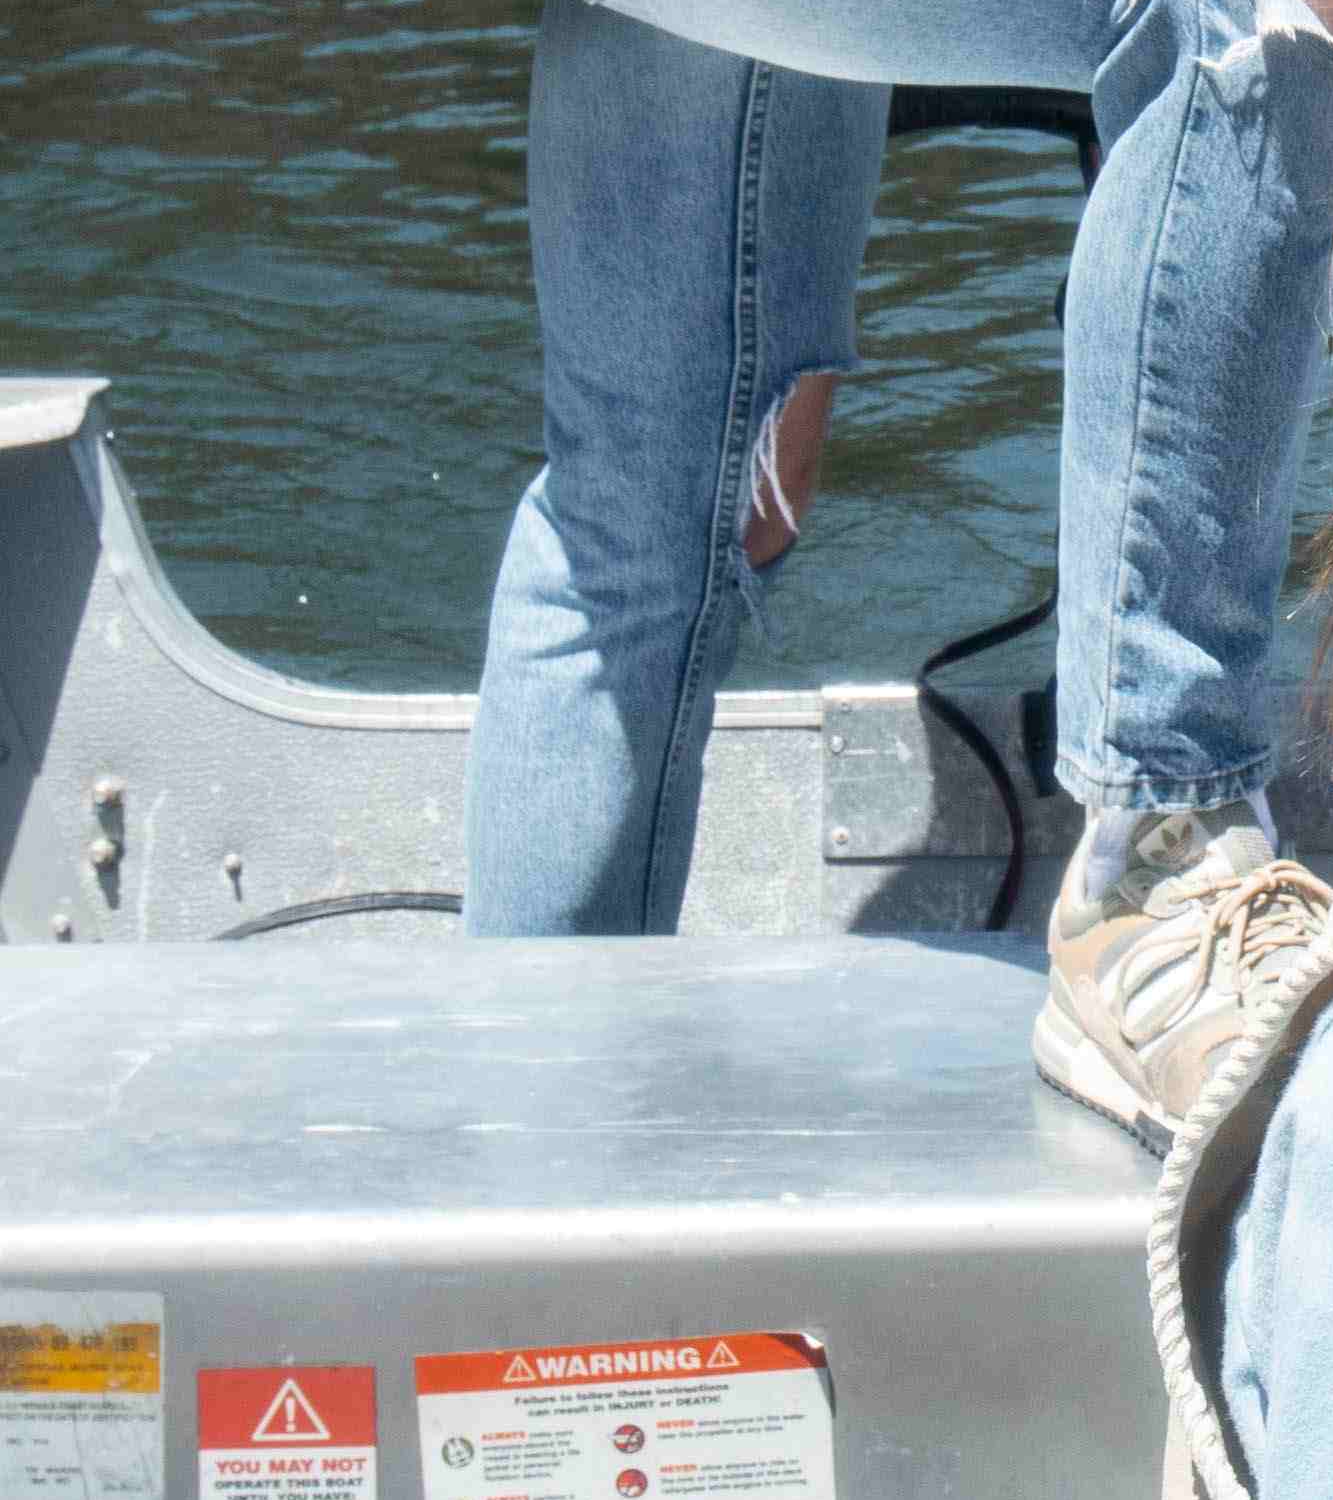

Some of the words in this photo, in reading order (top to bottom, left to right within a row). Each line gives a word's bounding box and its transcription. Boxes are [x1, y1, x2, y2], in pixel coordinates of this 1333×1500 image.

[536, 1347, 700, 1379] WARNING
[515, 1395, 556, 1406] Failure
[560, 1394, 573, 1403] to
[576, 1391, 613, 1402] follow
[618, 1388, 652, 1398] these
[656, 1383, 729, 1396] instructions
[607, 1400, 655, 1411] INJURY
[215, 1459, 261, 1475] YOU
[269, 1458, 314, 1473] MAY
[322, 1457, 368, 1472] NOT
[214, 1479, 281, 1490] OPERATE
[286, 1478, 320, 1488] THIS
[325, 1477, 364, 1487] BOAT
